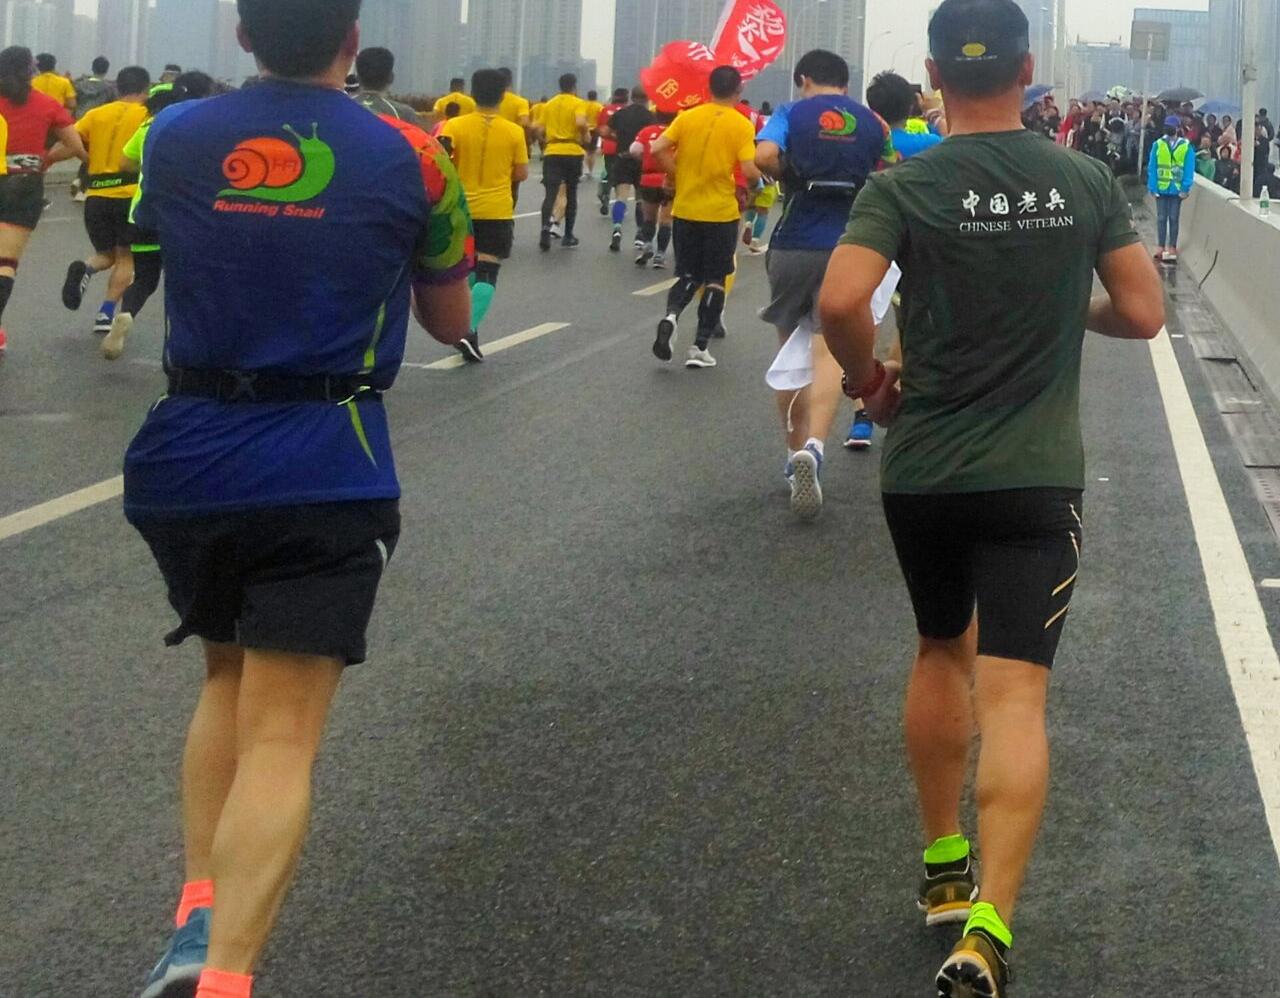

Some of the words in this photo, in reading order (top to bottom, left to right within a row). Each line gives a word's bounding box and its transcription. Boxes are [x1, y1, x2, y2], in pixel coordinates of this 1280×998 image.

[213, 200, 279, 216] Running
[283, 204, 325, 218] Snail
[961, 188, 1066, 218] 中国老兵
[959, 221, 1012, 232] CHINESE
[1017, 215, 1074, 229] VETERAN
